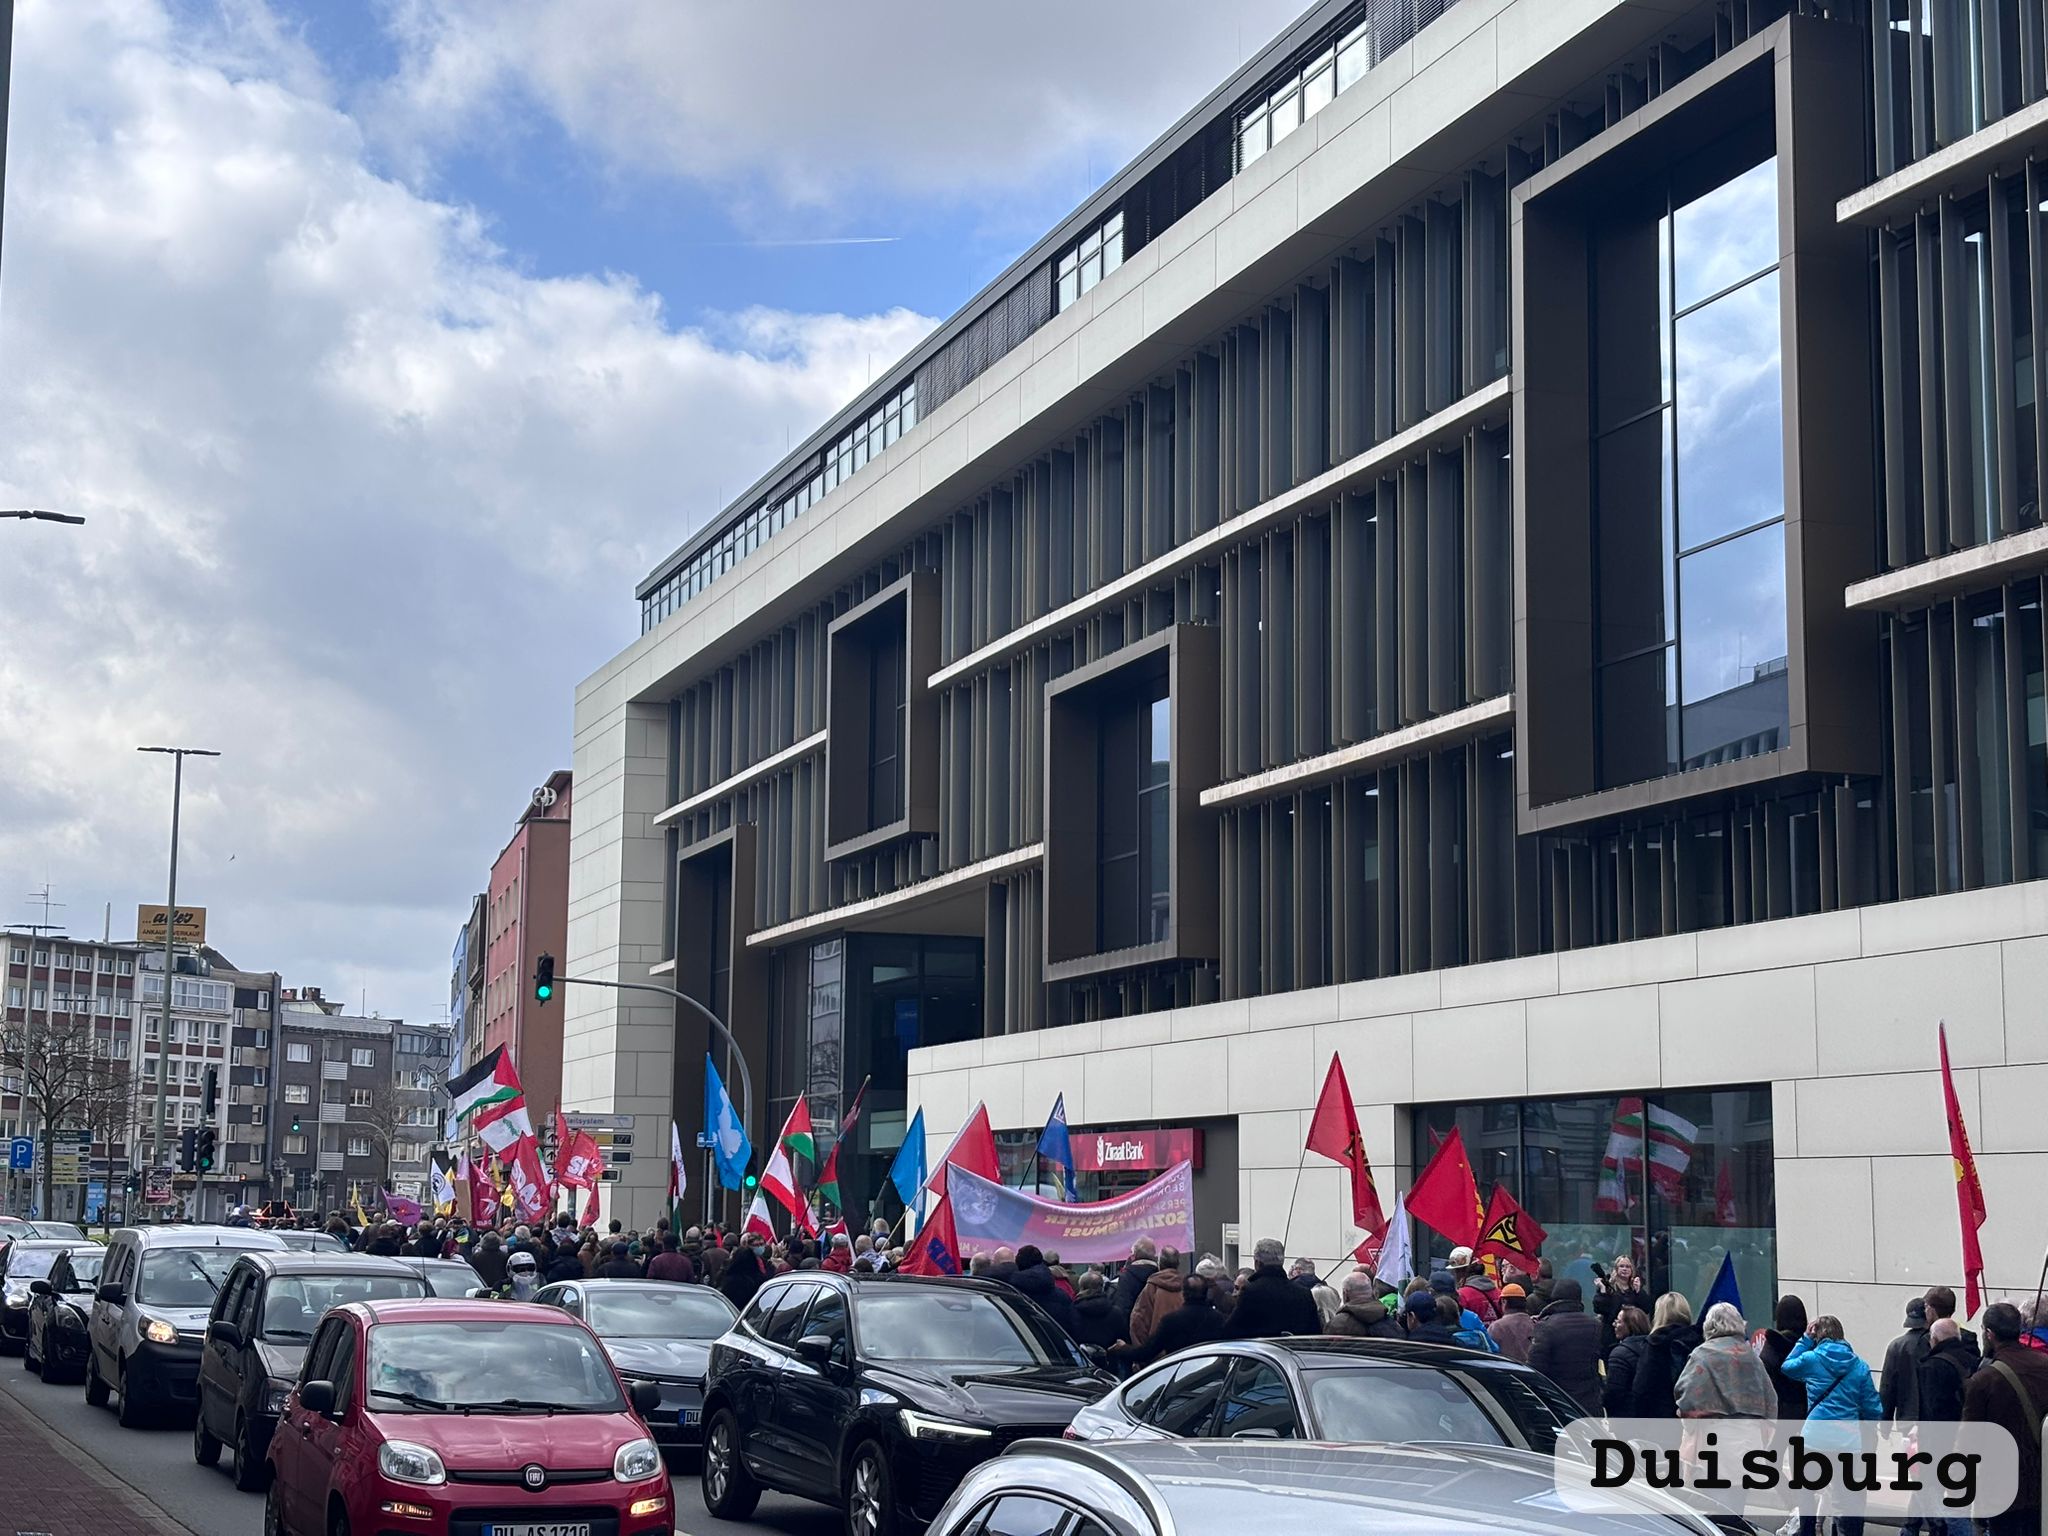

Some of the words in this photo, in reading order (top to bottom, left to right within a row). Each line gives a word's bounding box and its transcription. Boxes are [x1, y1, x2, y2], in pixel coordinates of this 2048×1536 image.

[17, 1144, 27, 1159] P
[1105, 1142, 1125, 1161] Ziraat
[1125, 1140, 1144, 1160] Bank
[687, 1411, 699, 1423] DU
[530, 1472, 541, 1482] FIAT
